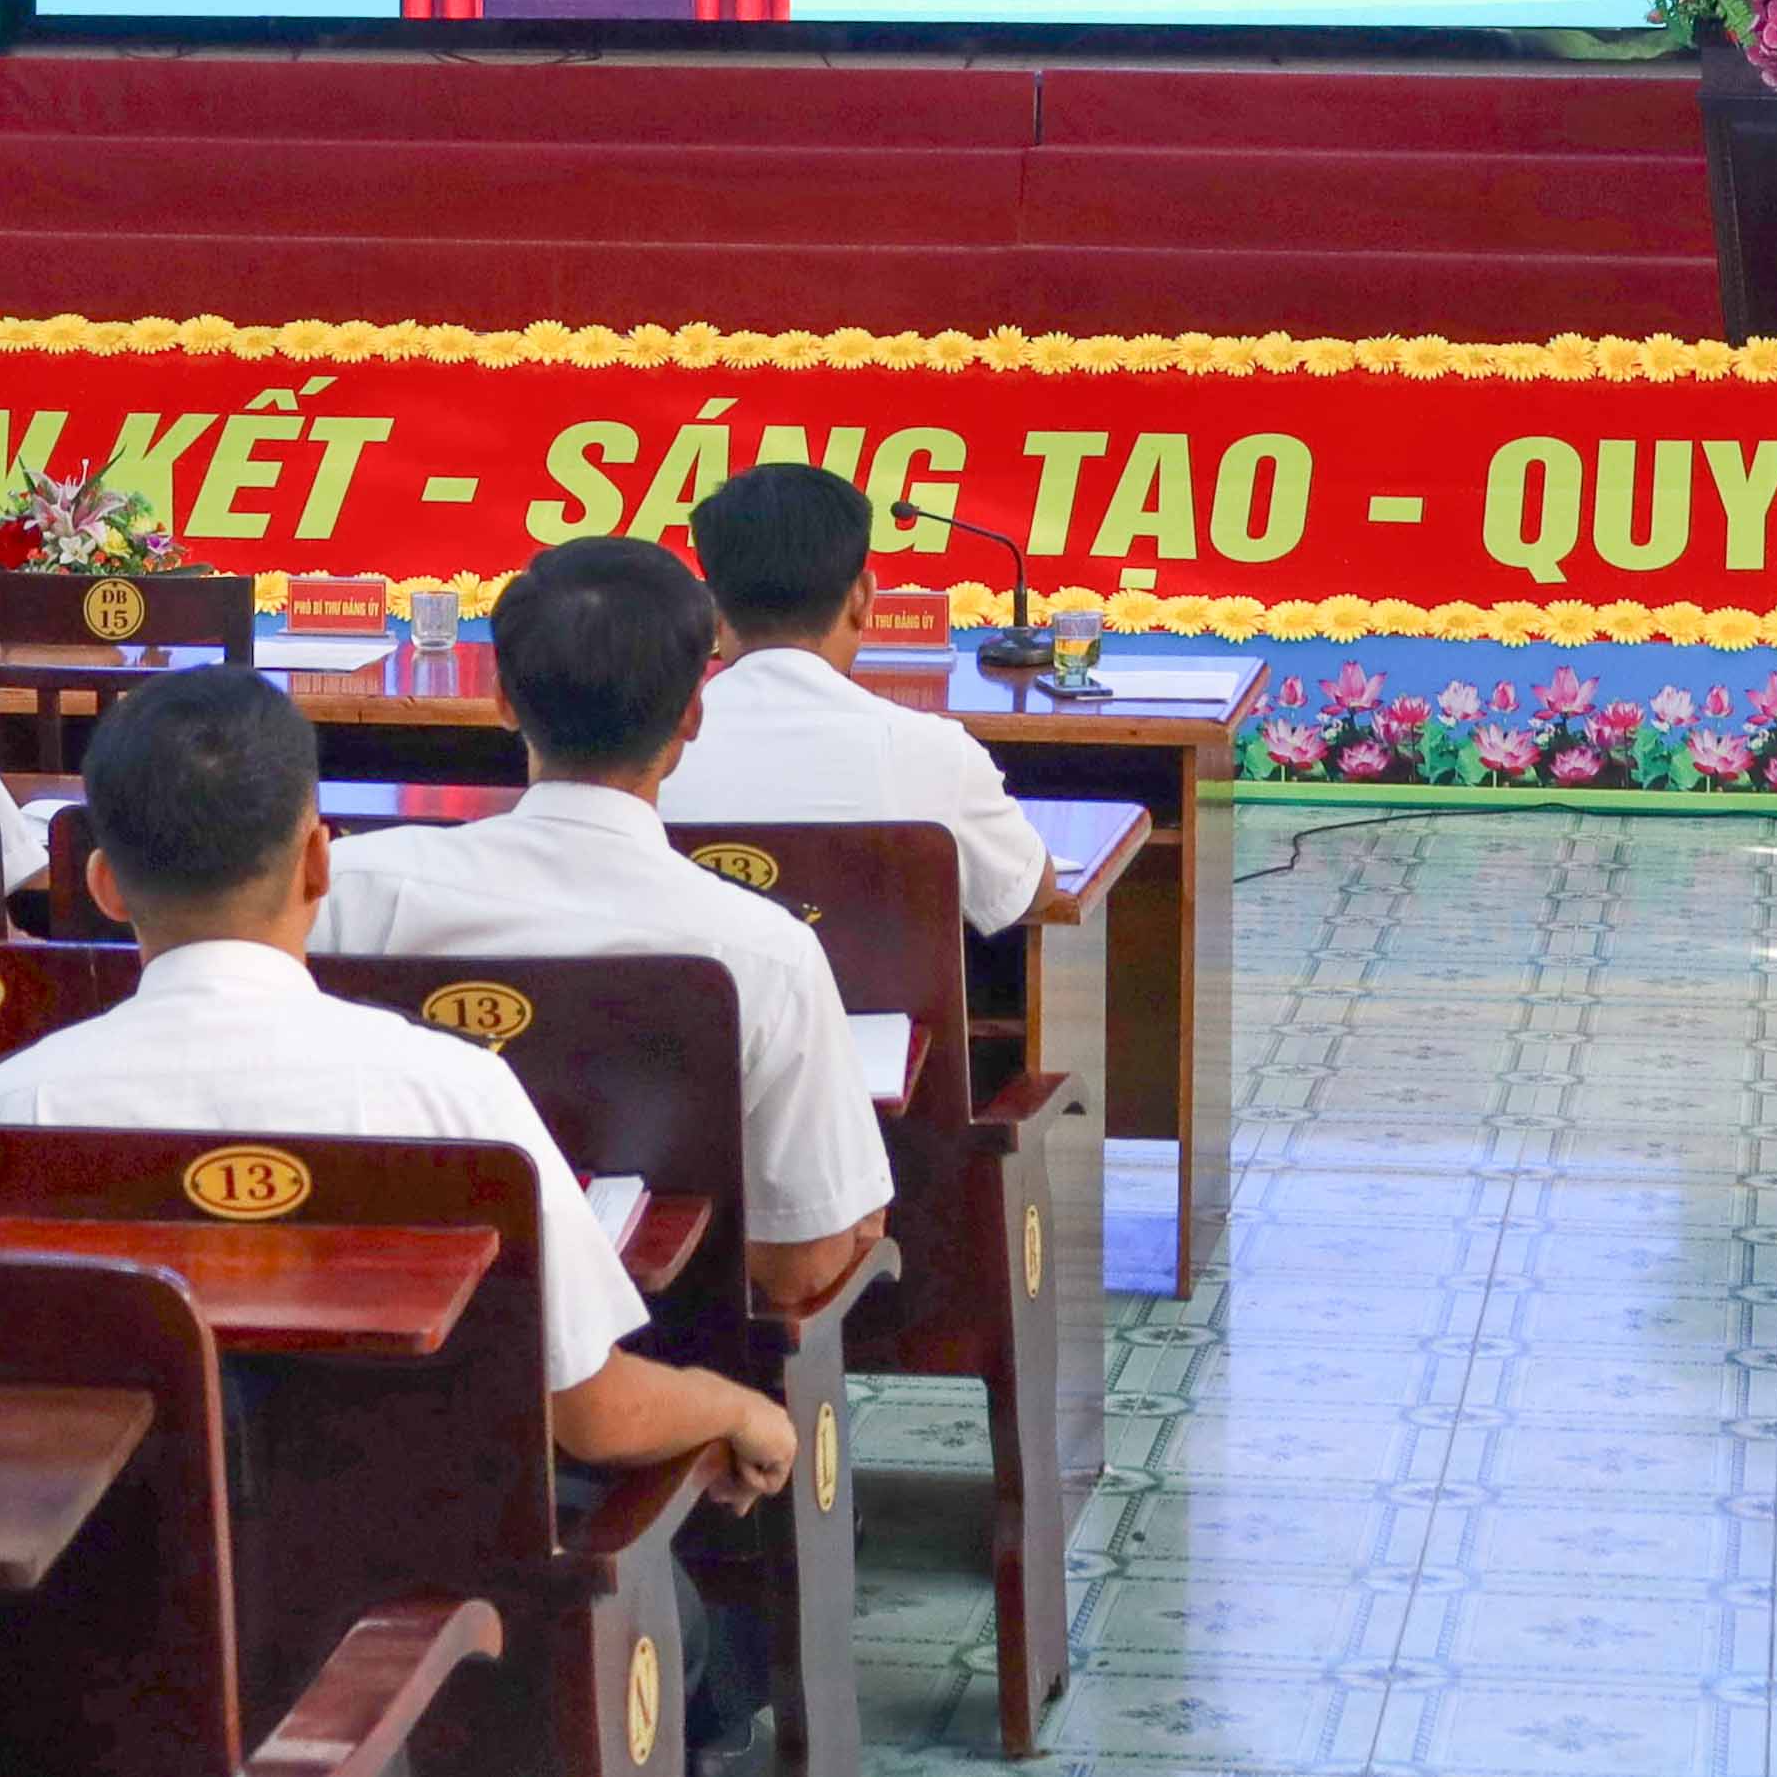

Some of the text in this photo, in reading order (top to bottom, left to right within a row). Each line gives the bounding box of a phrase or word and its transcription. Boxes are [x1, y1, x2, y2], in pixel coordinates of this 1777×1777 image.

[115, 376, 394, 539] KẾT
[1024, 432, 1312, 591] TẠO
[100, 610, 128, 627] 15
[454, 996, 502, 1028] 13
[220, 1164, 277, 1201] 13
